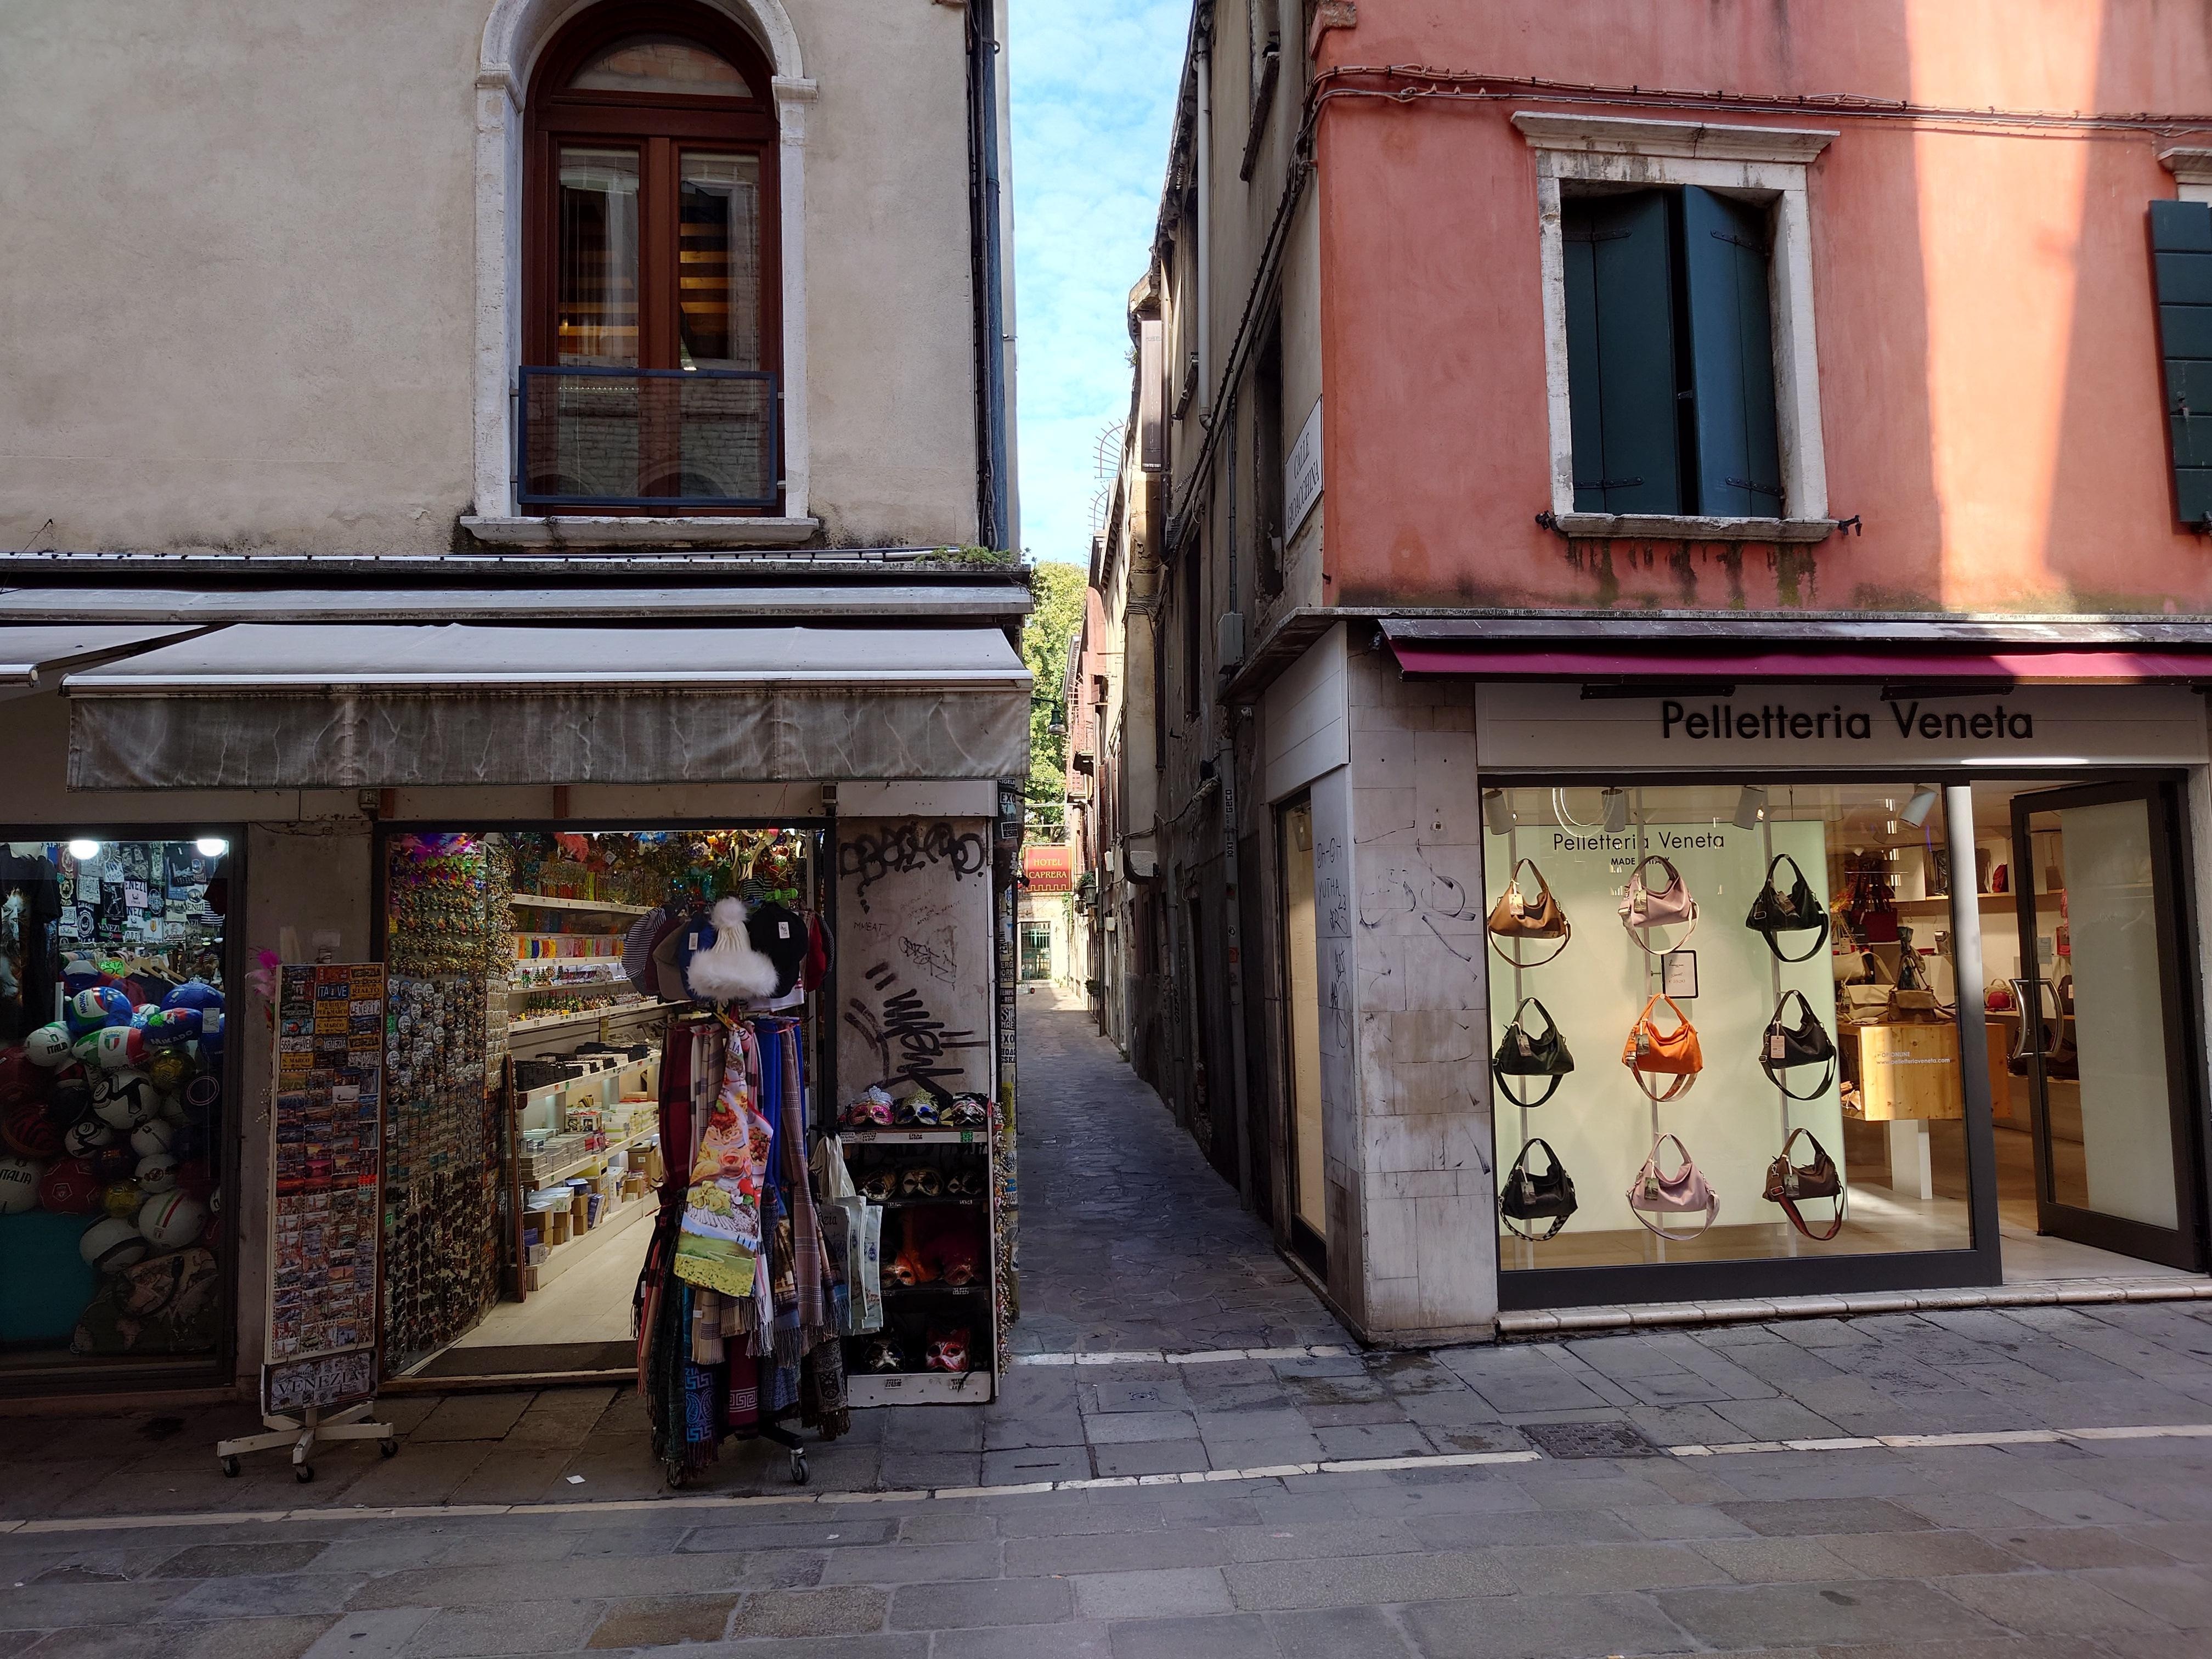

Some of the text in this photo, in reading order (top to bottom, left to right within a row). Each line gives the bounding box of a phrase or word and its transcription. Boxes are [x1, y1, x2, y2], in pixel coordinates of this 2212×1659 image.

[1294, 432, 1310, 479] CALLE
[1288, 459, 1319, 529] GIOACCHINA
[1662, 701, 2034, 739] Pelletteria Veneta
[1553, 831, 1725, 851] Pelletteria Veneta
[1033, 858, 1063, 866] HOTEL
[1029, 870, 1068, 879] CAPRERA
[350, 1003, 380, 1014] VENEZIA
[47, 1042, 67, 1054] ITALIA
[281, 1040, 291, 1050] 568
[279, 1370, 359, 1394] VENEZIA
